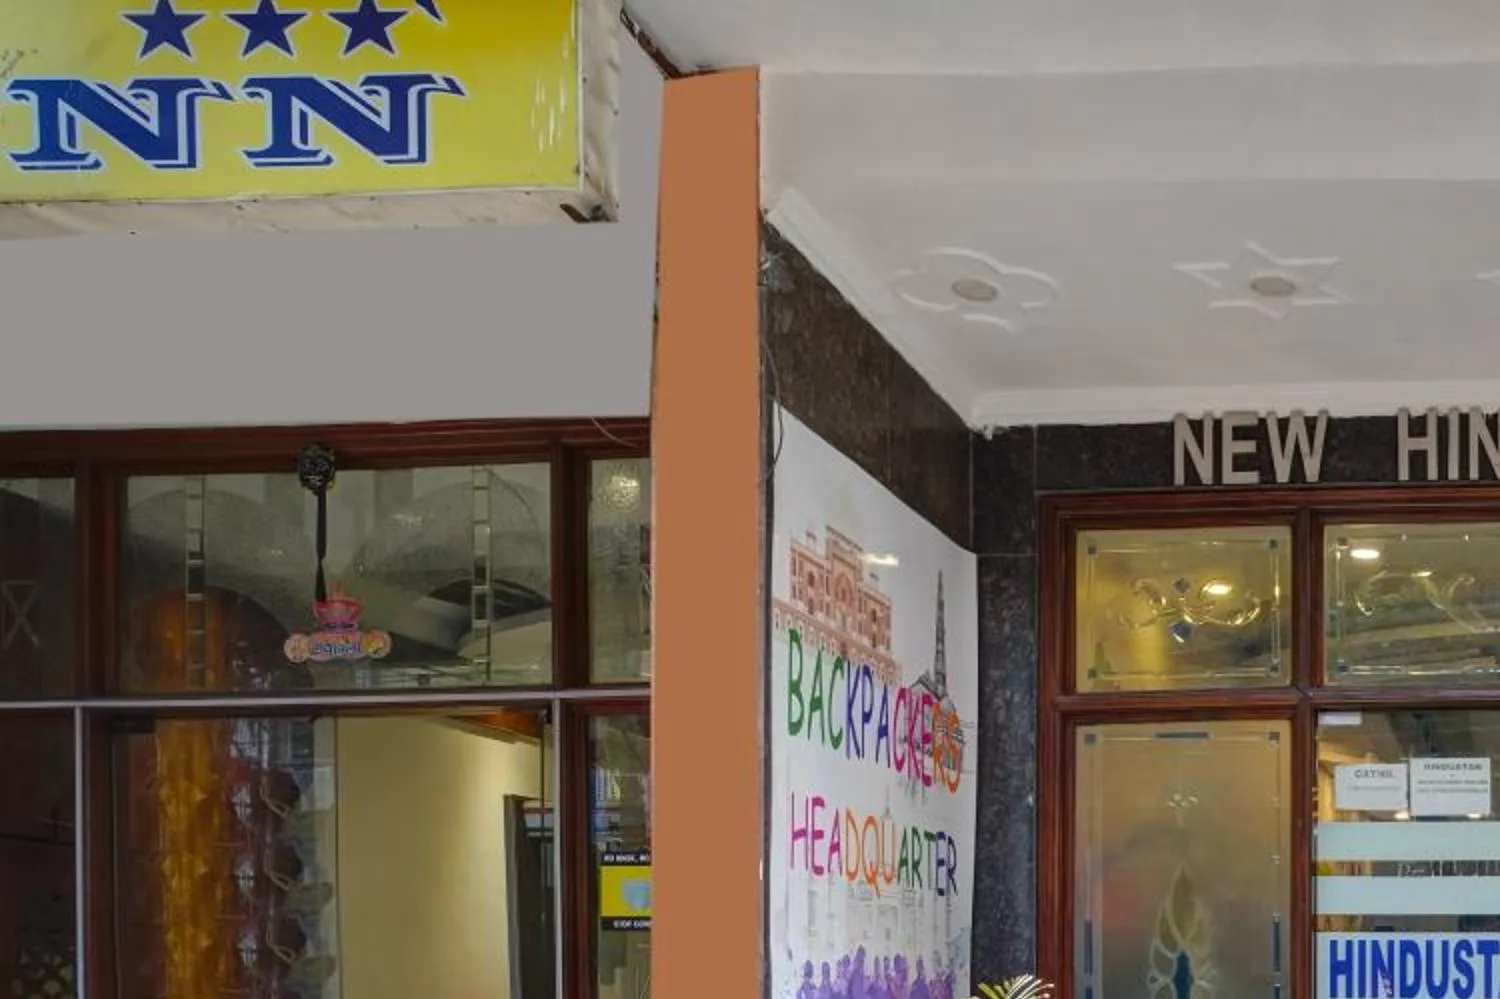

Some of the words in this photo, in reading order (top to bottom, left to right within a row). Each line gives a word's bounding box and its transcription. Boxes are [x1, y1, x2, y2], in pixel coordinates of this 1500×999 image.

[1172, 408, 1329, 486] NEW
[787, 627, 963, 794] BACKPACKERS
[789, 791, 959, 898] HEADQUARTER
